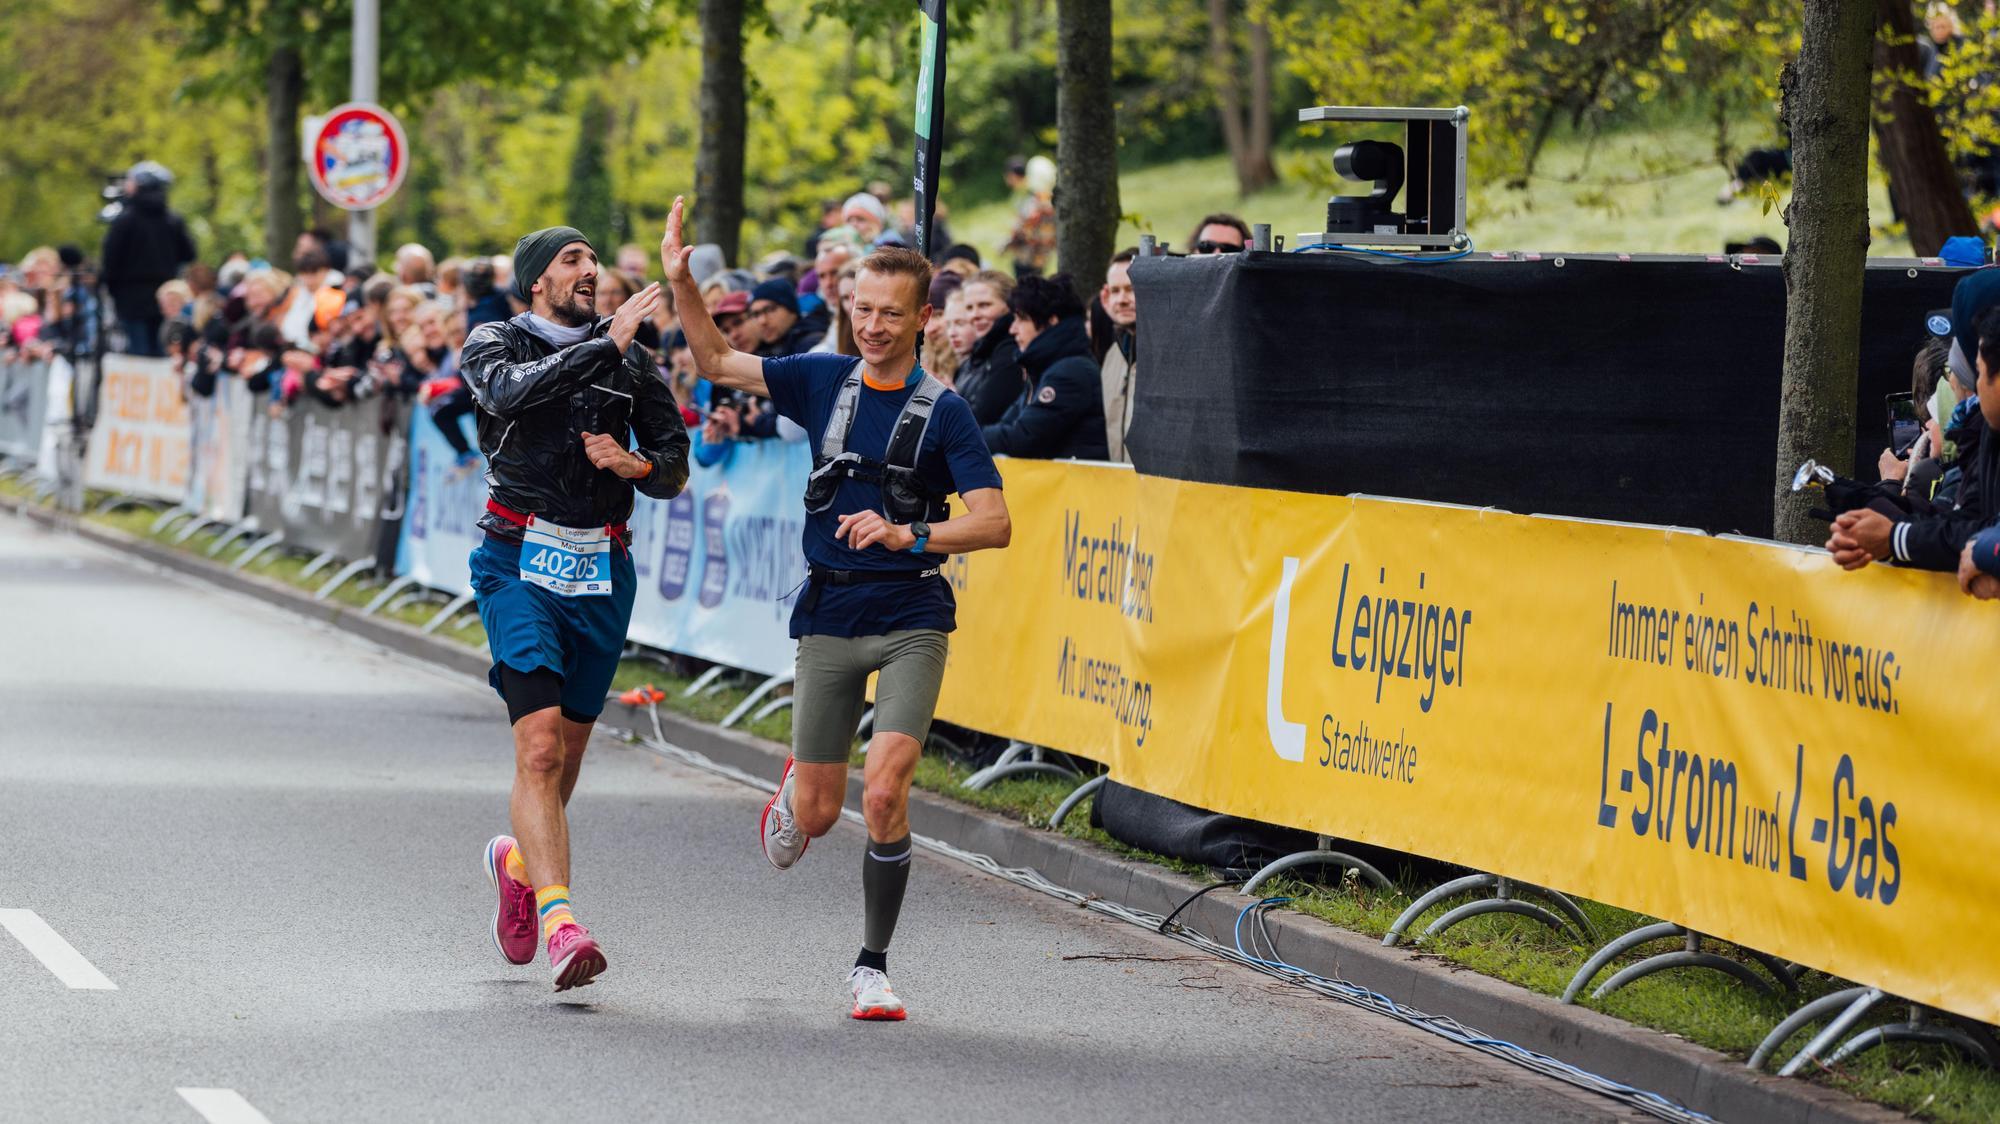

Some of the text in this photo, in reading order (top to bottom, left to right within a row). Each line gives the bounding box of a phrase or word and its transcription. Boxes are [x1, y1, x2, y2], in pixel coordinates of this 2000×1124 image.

[530, 549, 598, 579] 40205
[561, 541, 585, 553] Markus
[920, 566, 939, 577] 2XU
[1332, 563, 1472, 713] Leipziger
[1608, 580, 1901, 715] Immer einen Schritt voraus:
[1319, 714, 1417, 784] Stadtwerke
[1597, 702, 1901, 906] L-Strom und L-Gas
